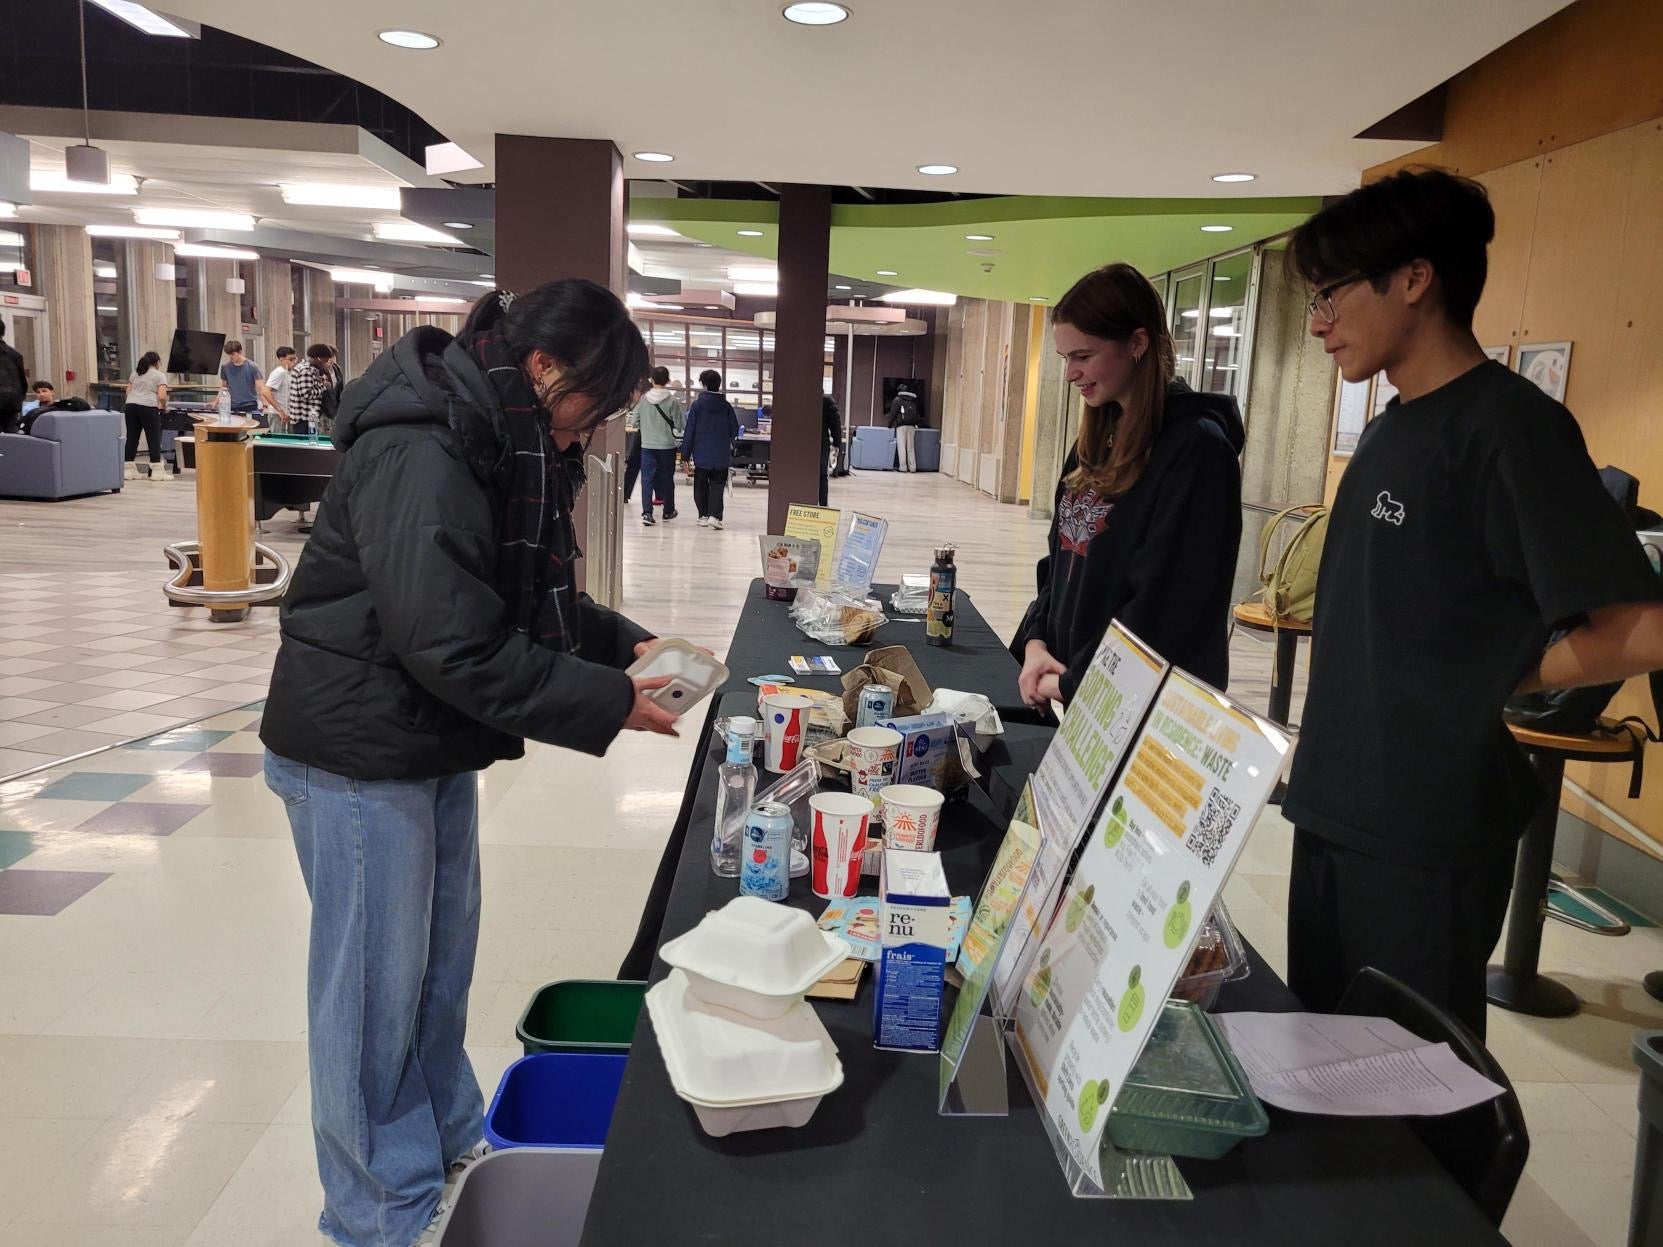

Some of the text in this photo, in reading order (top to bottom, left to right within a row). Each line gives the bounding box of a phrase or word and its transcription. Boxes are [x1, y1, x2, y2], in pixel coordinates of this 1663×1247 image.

[789, 509, 820, 519] FREE STORE
[1107, 652, 1121, 675] THE
[1079, 664, 1123, 731] SORTING
[1060, 702, 1114, 792] CHALLENGE
[1198, 743, 1234, 783] WASTE
[888, 924, 914, 937] nu
[887, 950, 912, 961] frais
